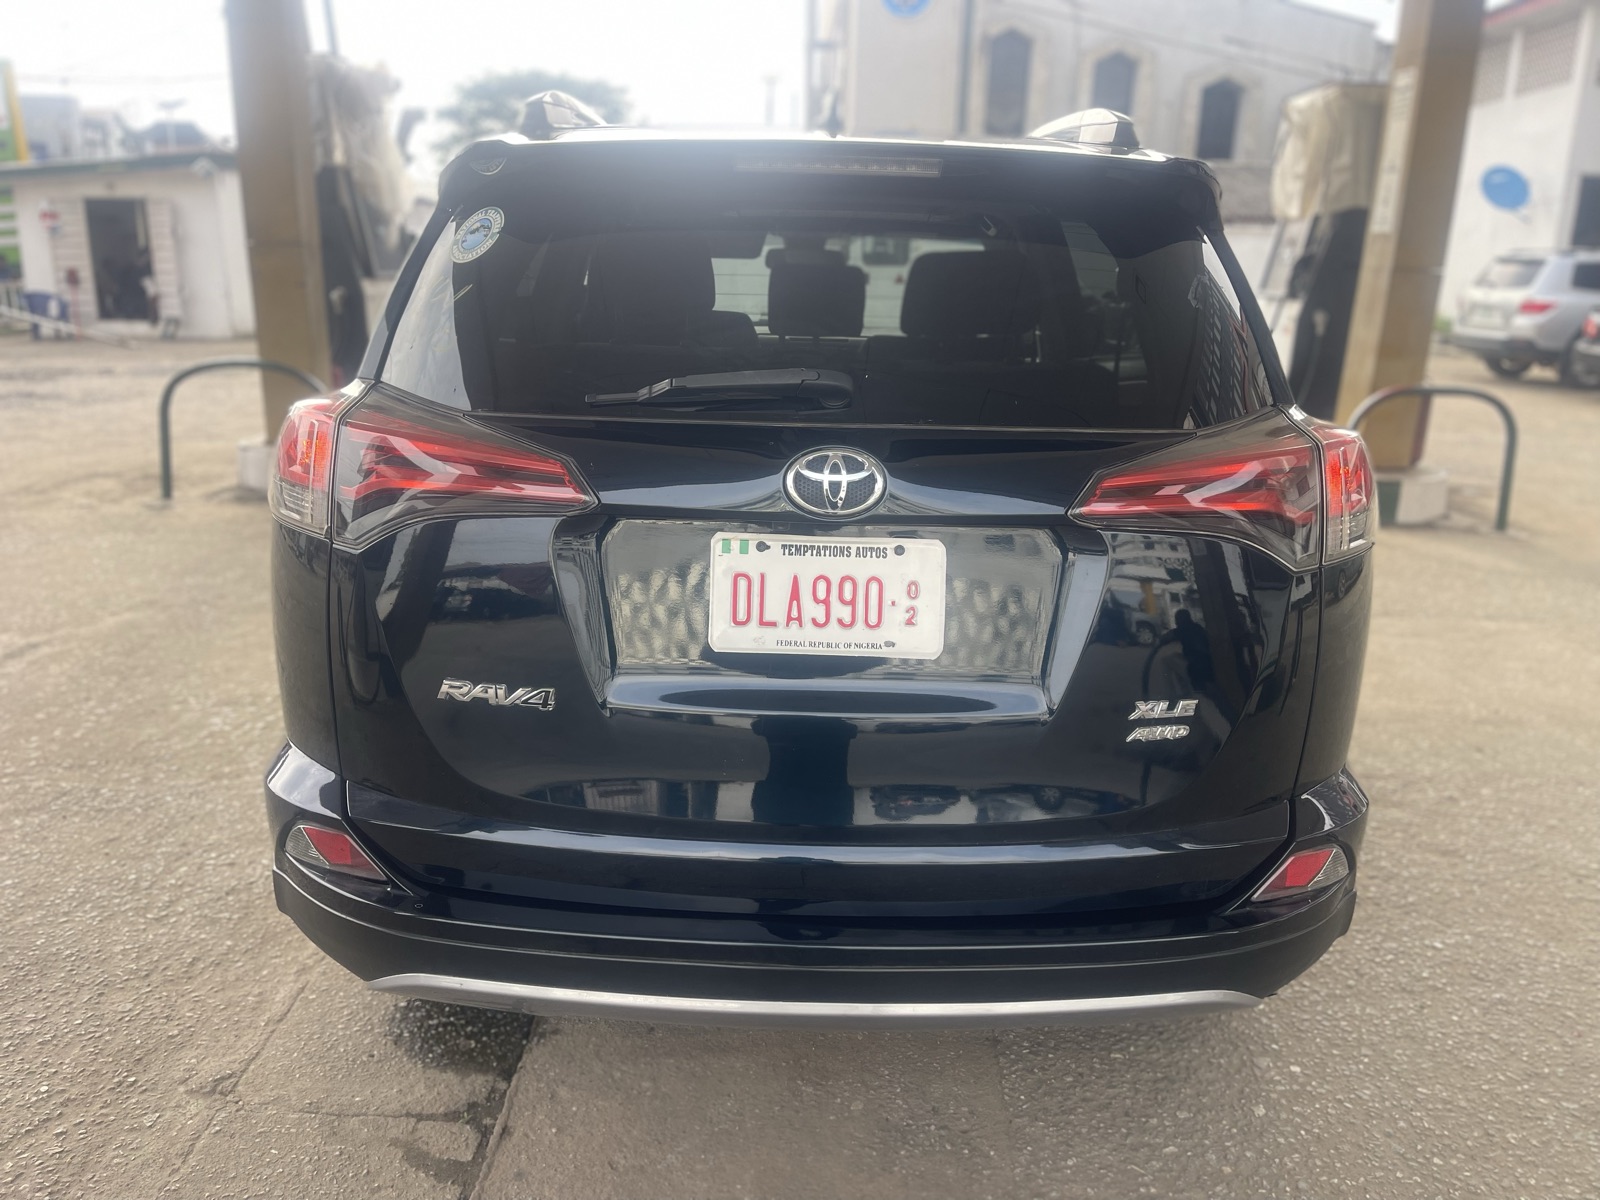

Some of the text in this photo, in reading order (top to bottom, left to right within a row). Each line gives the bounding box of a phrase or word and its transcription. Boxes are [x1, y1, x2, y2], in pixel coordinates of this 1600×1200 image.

[781, 543, 888, 560] TEMPTATIONS AUTOS
[776, 639, 883, 650] FEDERAL REPUBLIC OF NIGERIA
[437, 677, 555, 711] RAV4
[1128, 699, 1199, 720] XLE
[1125, 725, 1191, 742] AWD
